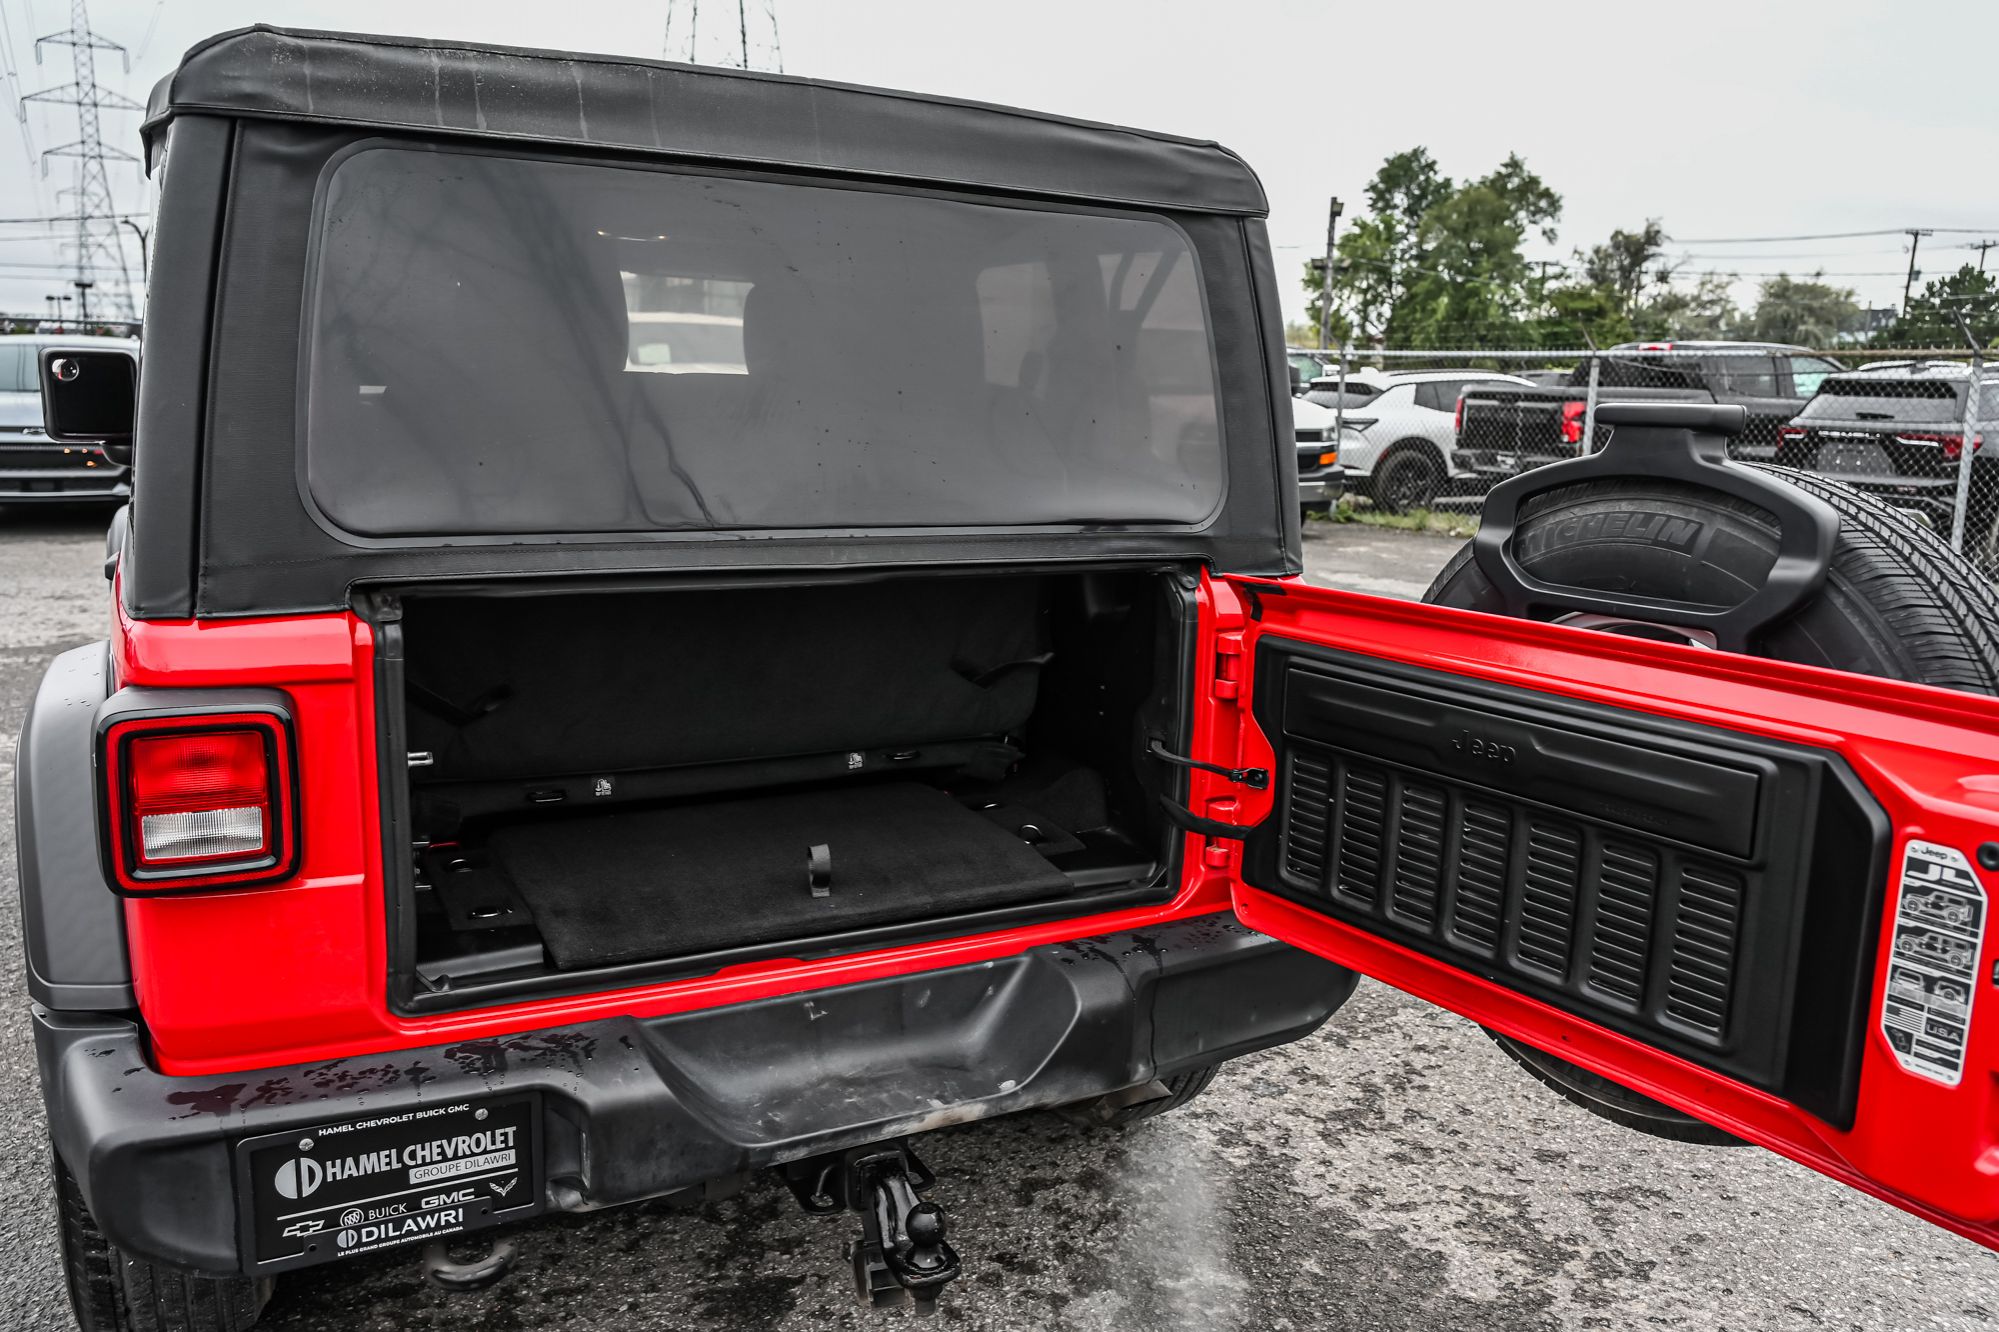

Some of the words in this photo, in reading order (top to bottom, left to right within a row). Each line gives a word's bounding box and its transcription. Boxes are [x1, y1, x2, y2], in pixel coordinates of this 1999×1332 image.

[1451, 729, 1517, 763] Jeep
[1921, 847, 1948, 860] Jeep
[1906, 863, 1974, 887] JL
[318, 1124, 354, 1136] HAMEL
[356, 1113, 414, 1129] CHEVROLET
[416, 1107, 446, 1119] BUICK
[448, 1104, 470, 1113] GMC
[326, 1148, 402, 1182] HAMEL
[403, 1126, 517, 1166] CHEVROLET
[414, 1163, 461, 1179] GROUPE
[465, 1153, 511, 1170] DILAWRI
[368, 1203, 407, 1220] BUICK
[421, 1188, 475, 1209] GMC
[361, 1208, 463, 1242] DILAWRI
